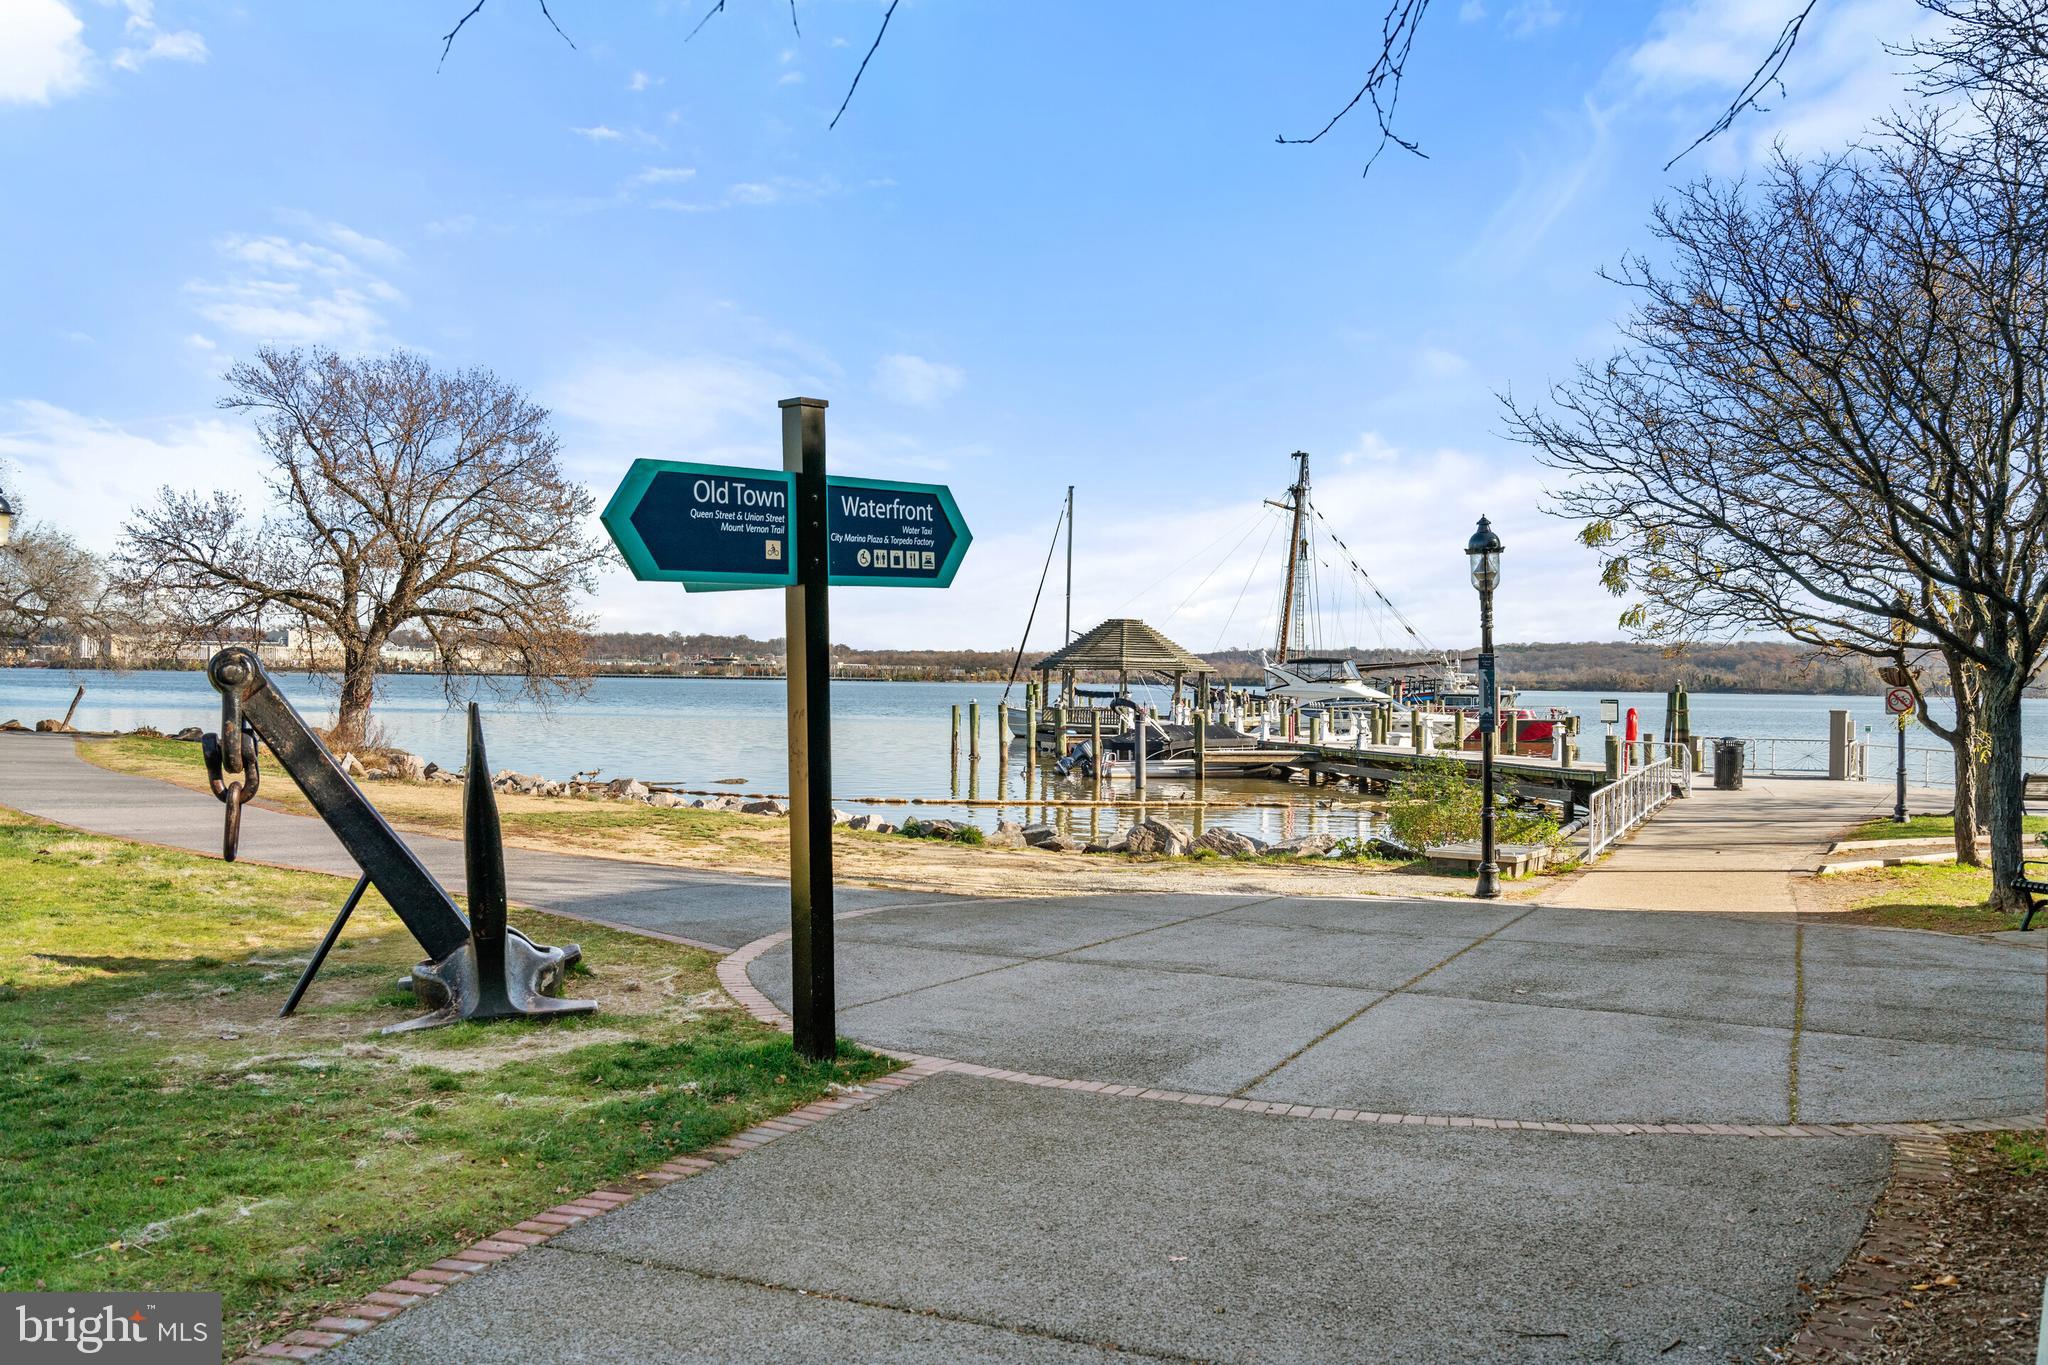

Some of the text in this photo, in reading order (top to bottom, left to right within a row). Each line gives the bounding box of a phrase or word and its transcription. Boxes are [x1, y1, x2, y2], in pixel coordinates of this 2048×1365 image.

[693, 479, 785, 509] Old Town
[690, 508, 785, 523] Queen Street & Union Street
[841, 495, 934, 522] Waterfront
[720, 522, 785, 534] Mount Vernon Trail
[902, 525, 933, 535] Water Taxi
[830, 532, 935, 548] City Marina Plaza & Torpedo Factory
